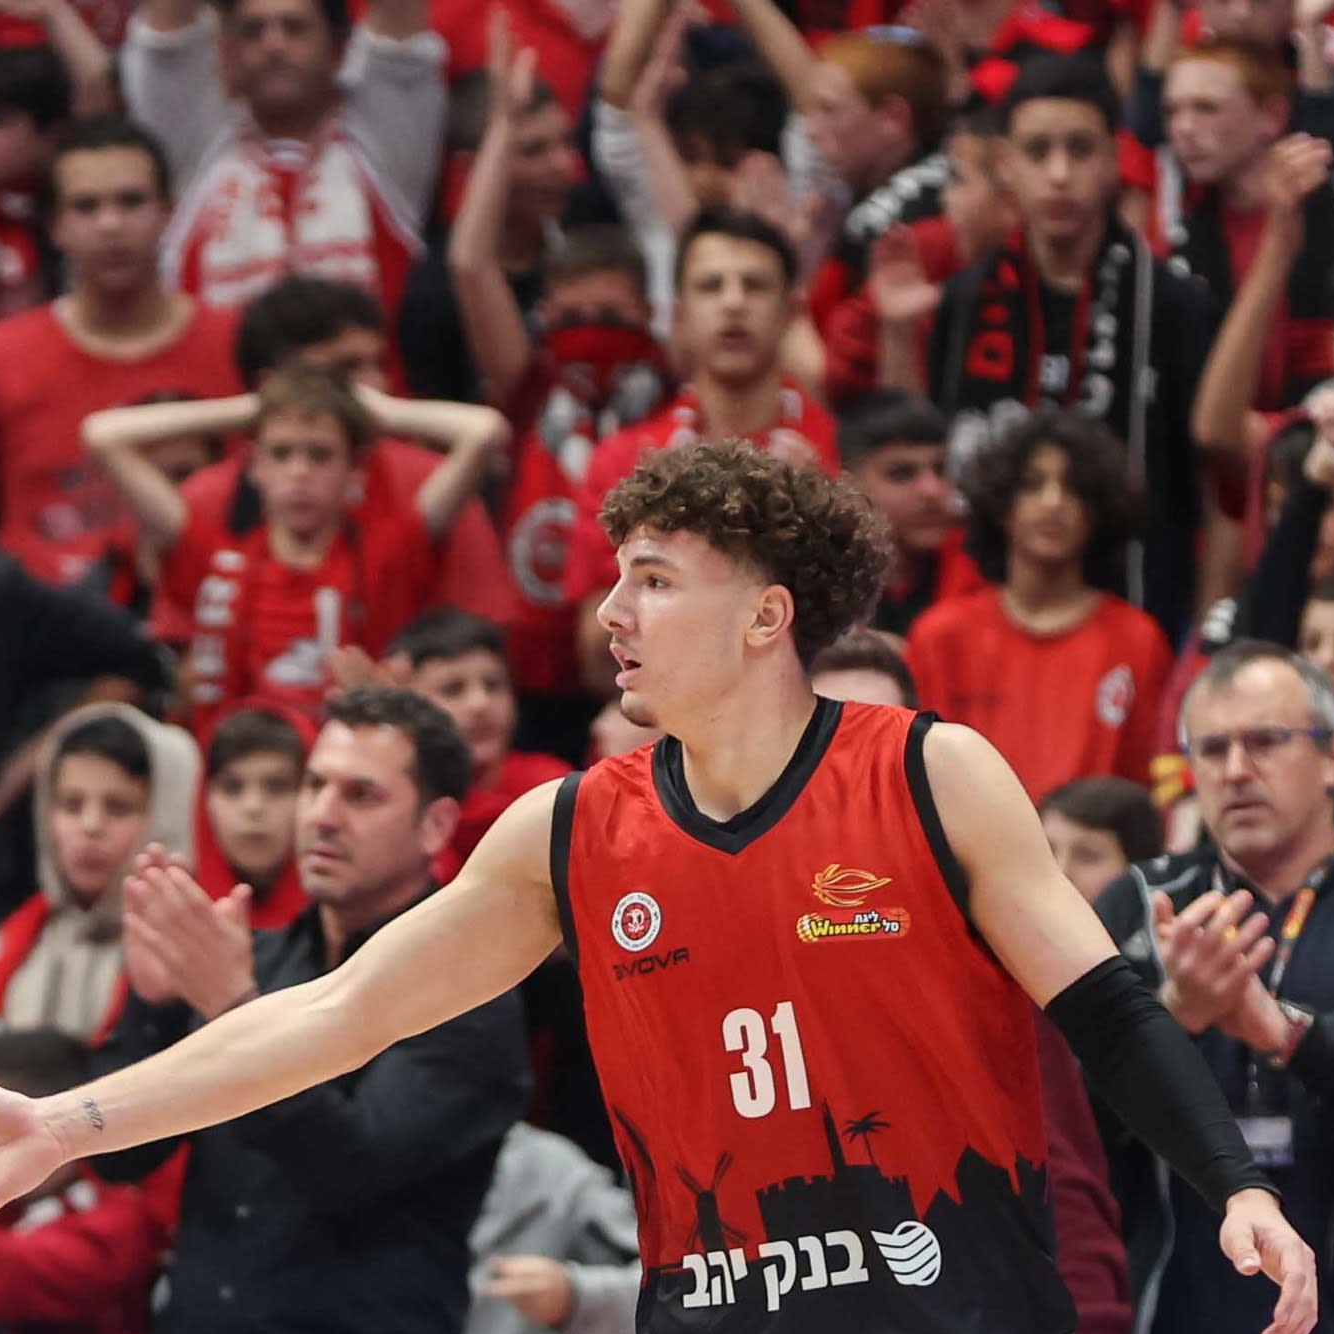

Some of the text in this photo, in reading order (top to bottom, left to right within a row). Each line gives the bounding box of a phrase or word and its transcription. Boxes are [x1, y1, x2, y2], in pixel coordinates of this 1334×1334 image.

[810, 919, 882, 937] Winner
[722, 1001, 811, 1118] 31
[682, 1230, 869, 1312] בנק יהב
